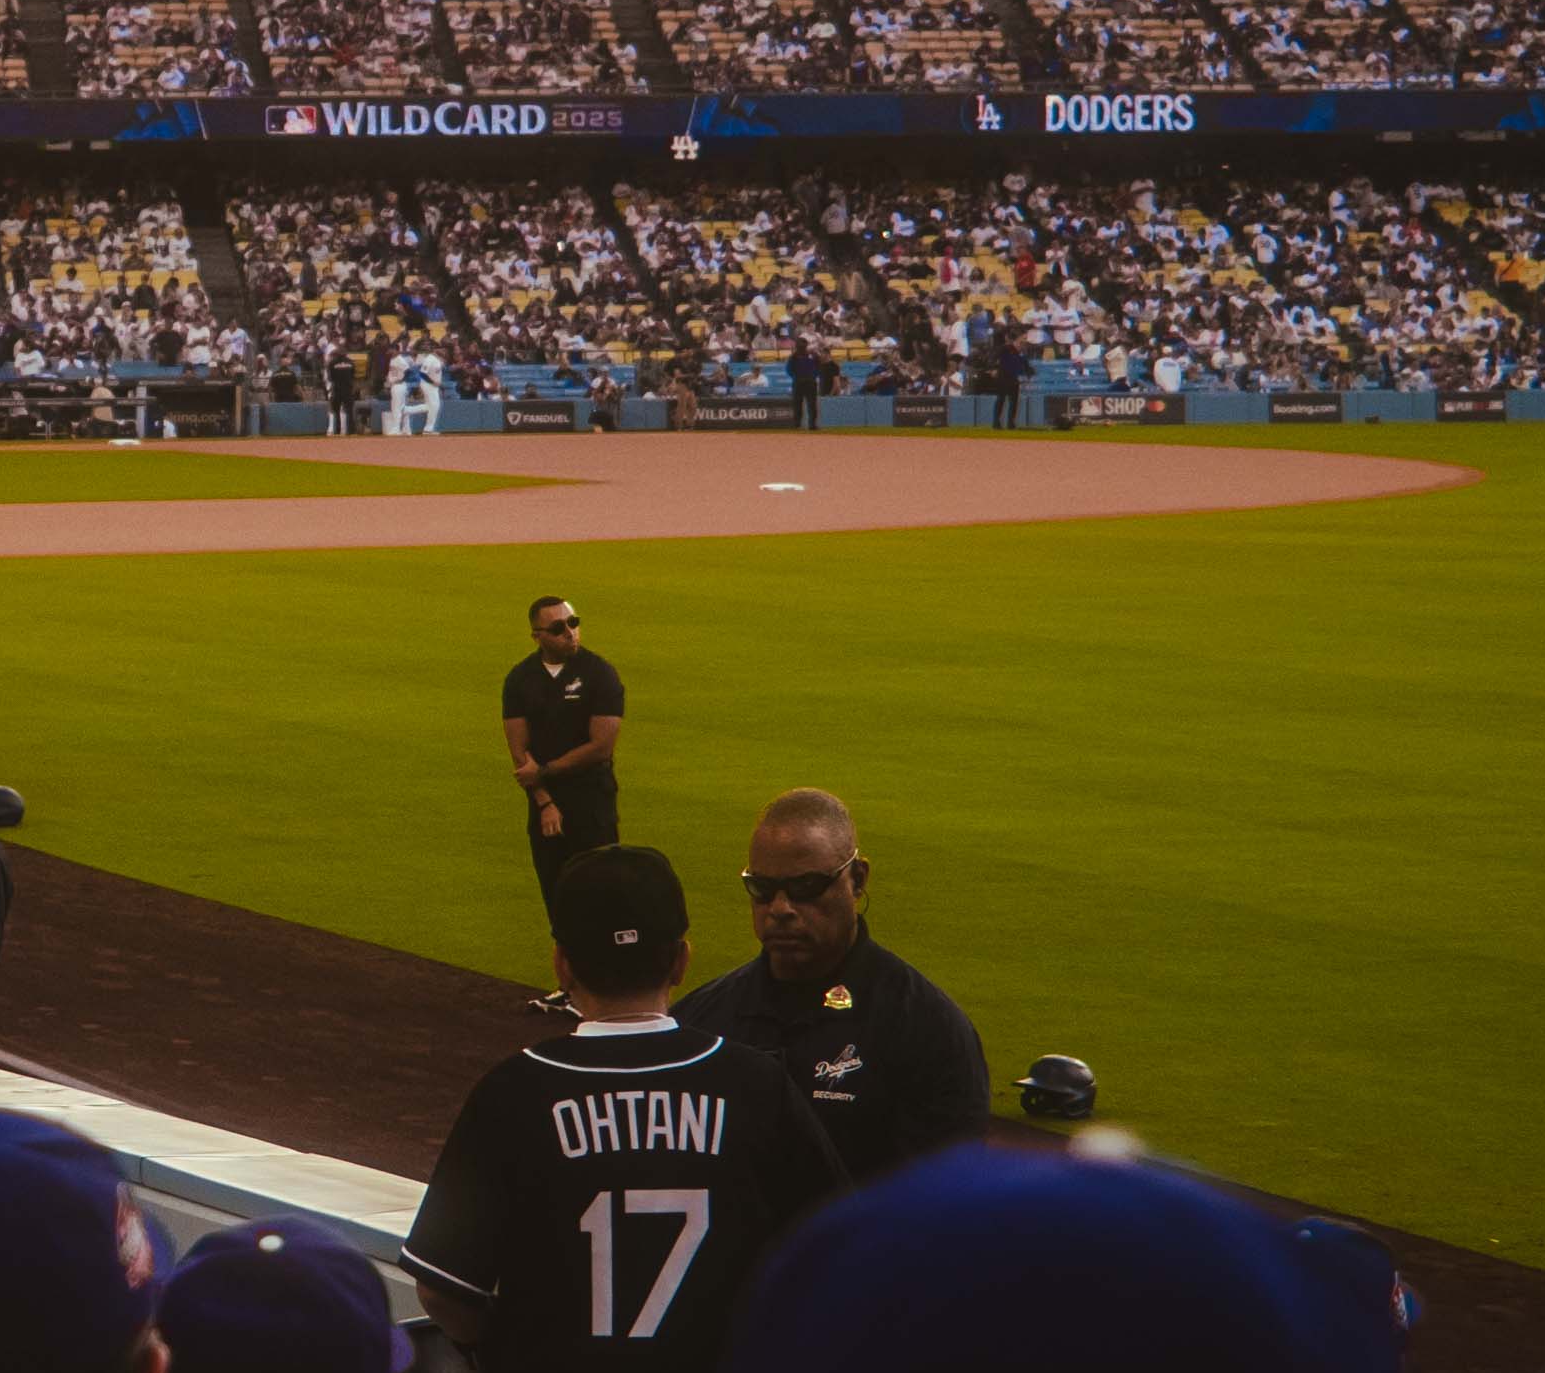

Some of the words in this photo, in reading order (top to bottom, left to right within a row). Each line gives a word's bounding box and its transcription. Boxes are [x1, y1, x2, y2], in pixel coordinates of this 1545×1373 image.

[552, 110, 623, 129] 2025
[1044, 93, 1197, 133] DODGERS
[1104, 397, 1145, 415] SHOP
[1272, 402, 1338, 416] Booking.com
[522, 412, 570, 425] FANDUEL
[813, 1054, 864, 1079] Dodgers
[812, 1089, 857, 1102] SECURITY
[552, 1090, 726, 1159] OHTANI
[579, 1187, 710, 1339] 17
